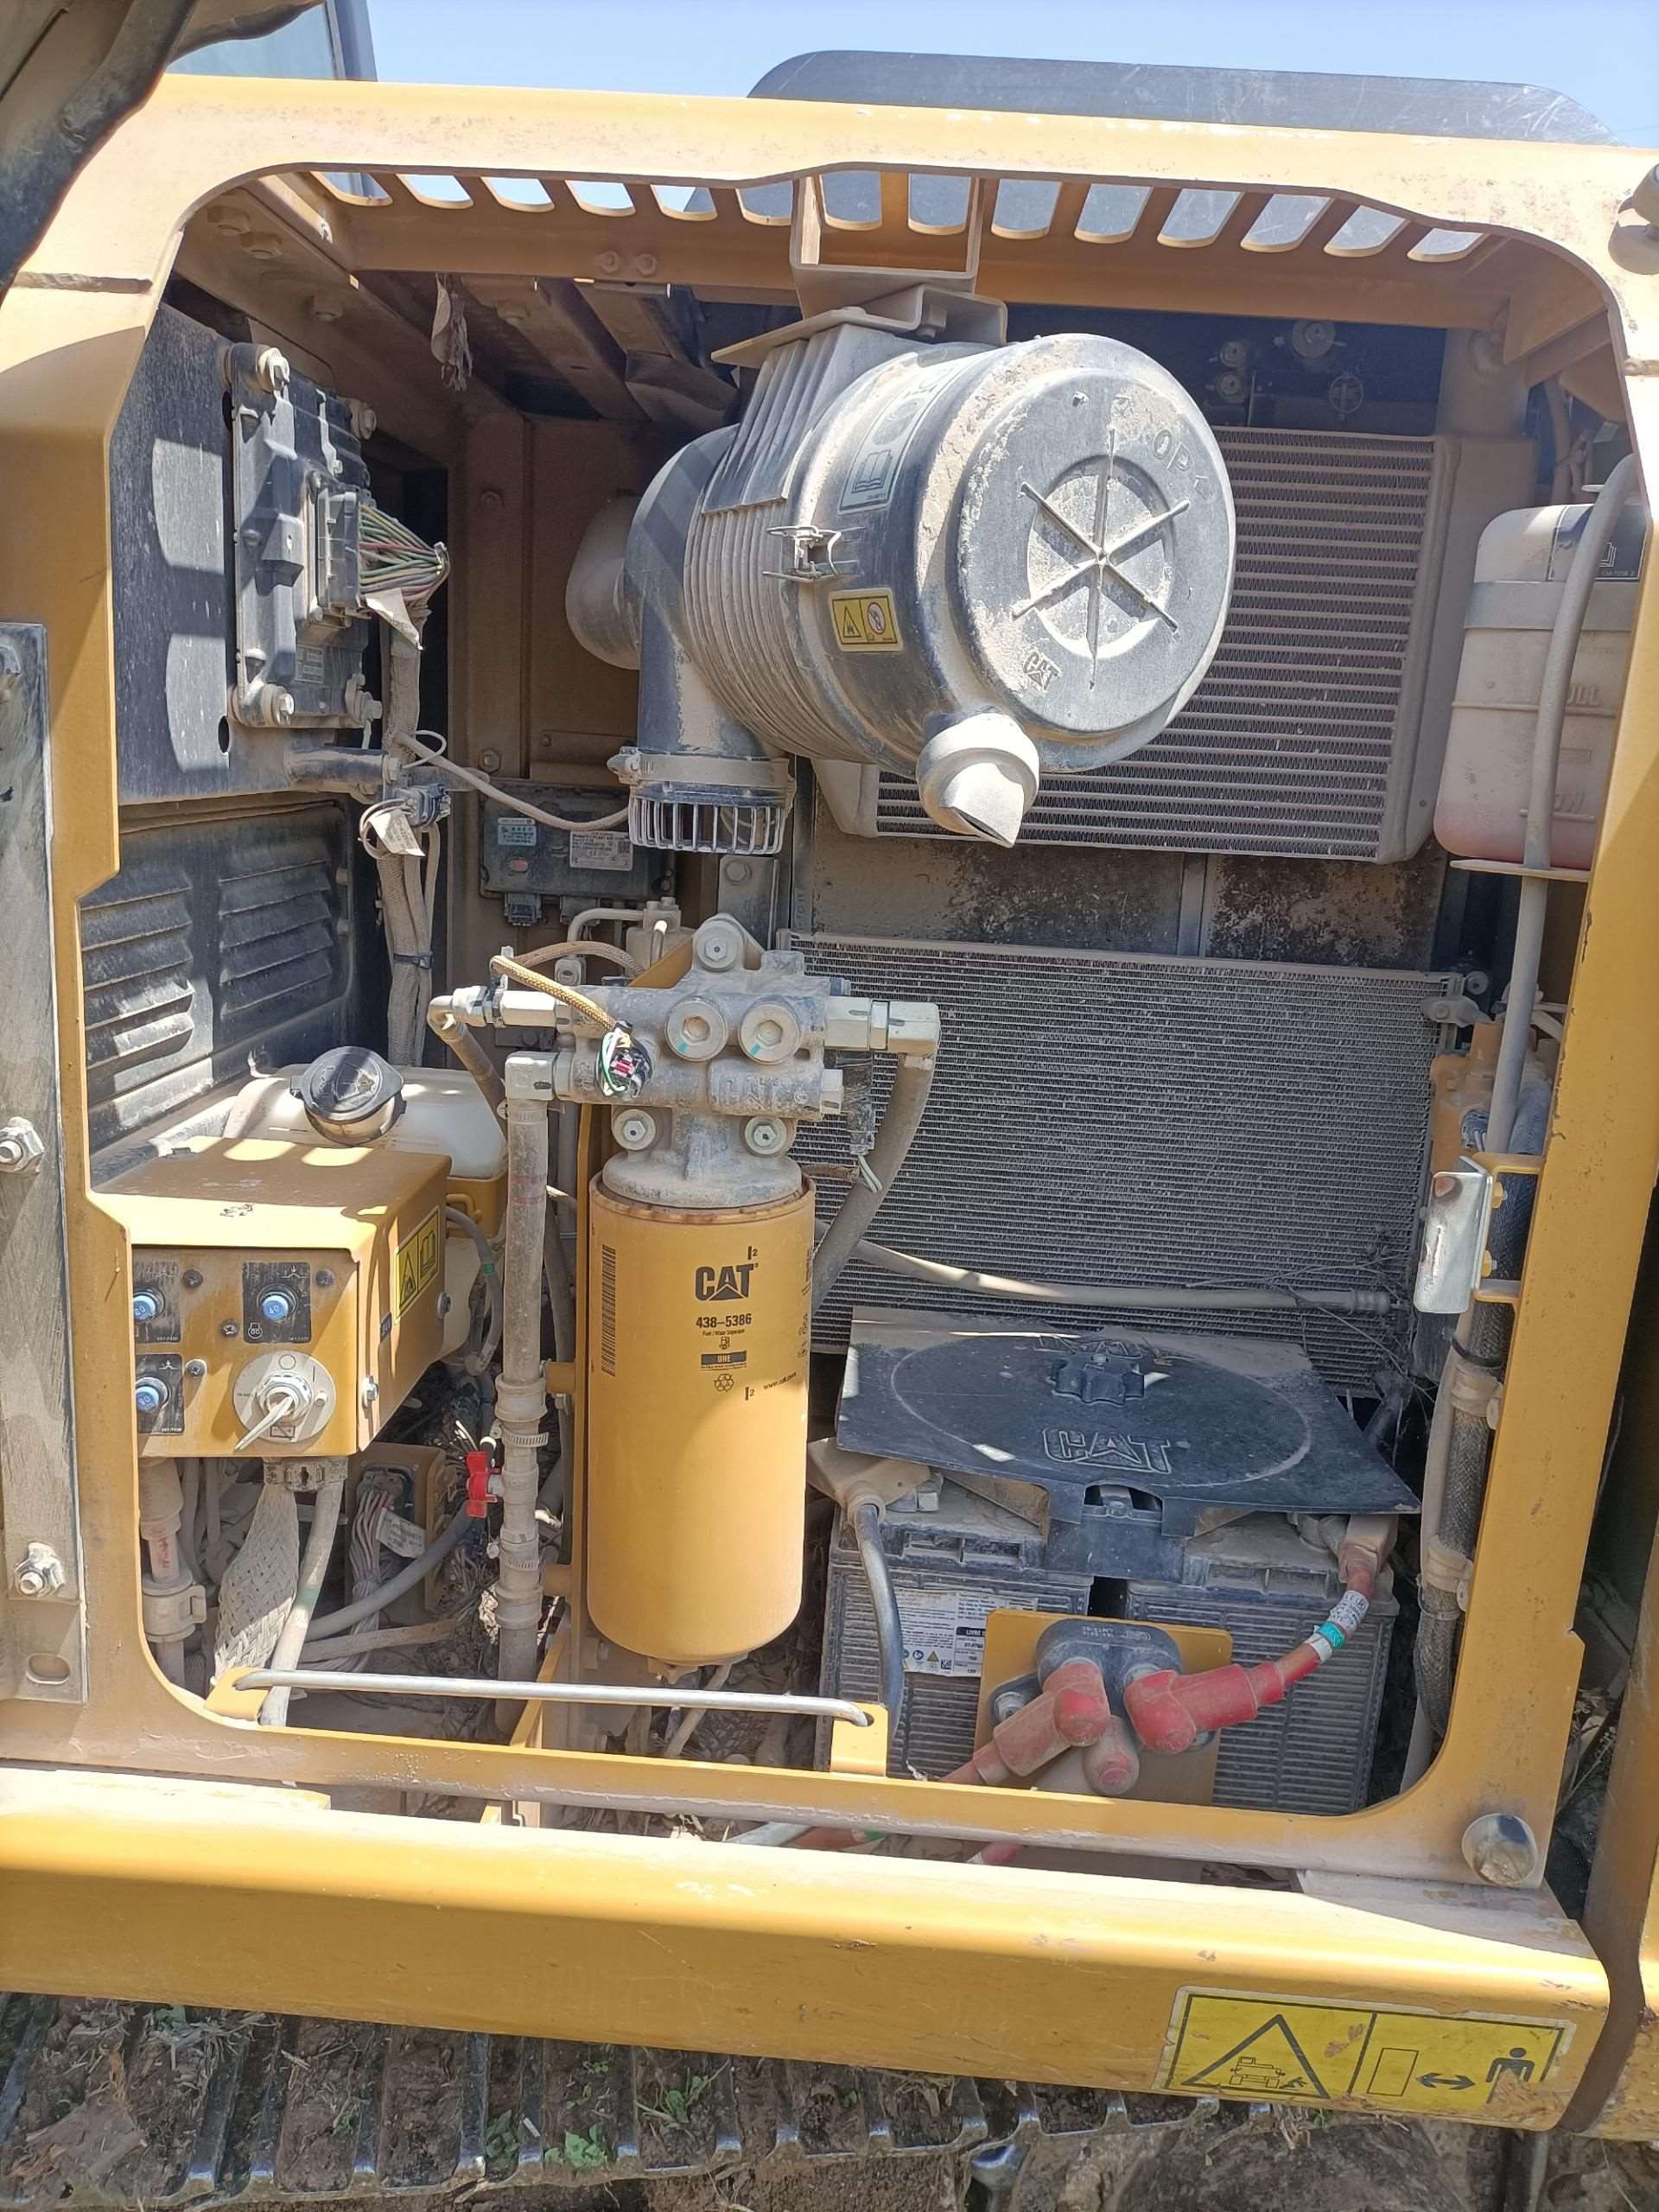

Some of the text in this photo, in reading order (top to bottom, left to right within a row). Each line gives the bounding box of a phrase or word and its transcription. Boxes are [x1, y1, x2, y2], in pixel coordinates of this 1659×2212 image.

[1023, 651, 1063, 691] CAT
[695, 1263, 753, 1301] CAT
[696, 1313, 752, 1328] 438-5386
[1043, 1427, 1172, 1475] CAT
